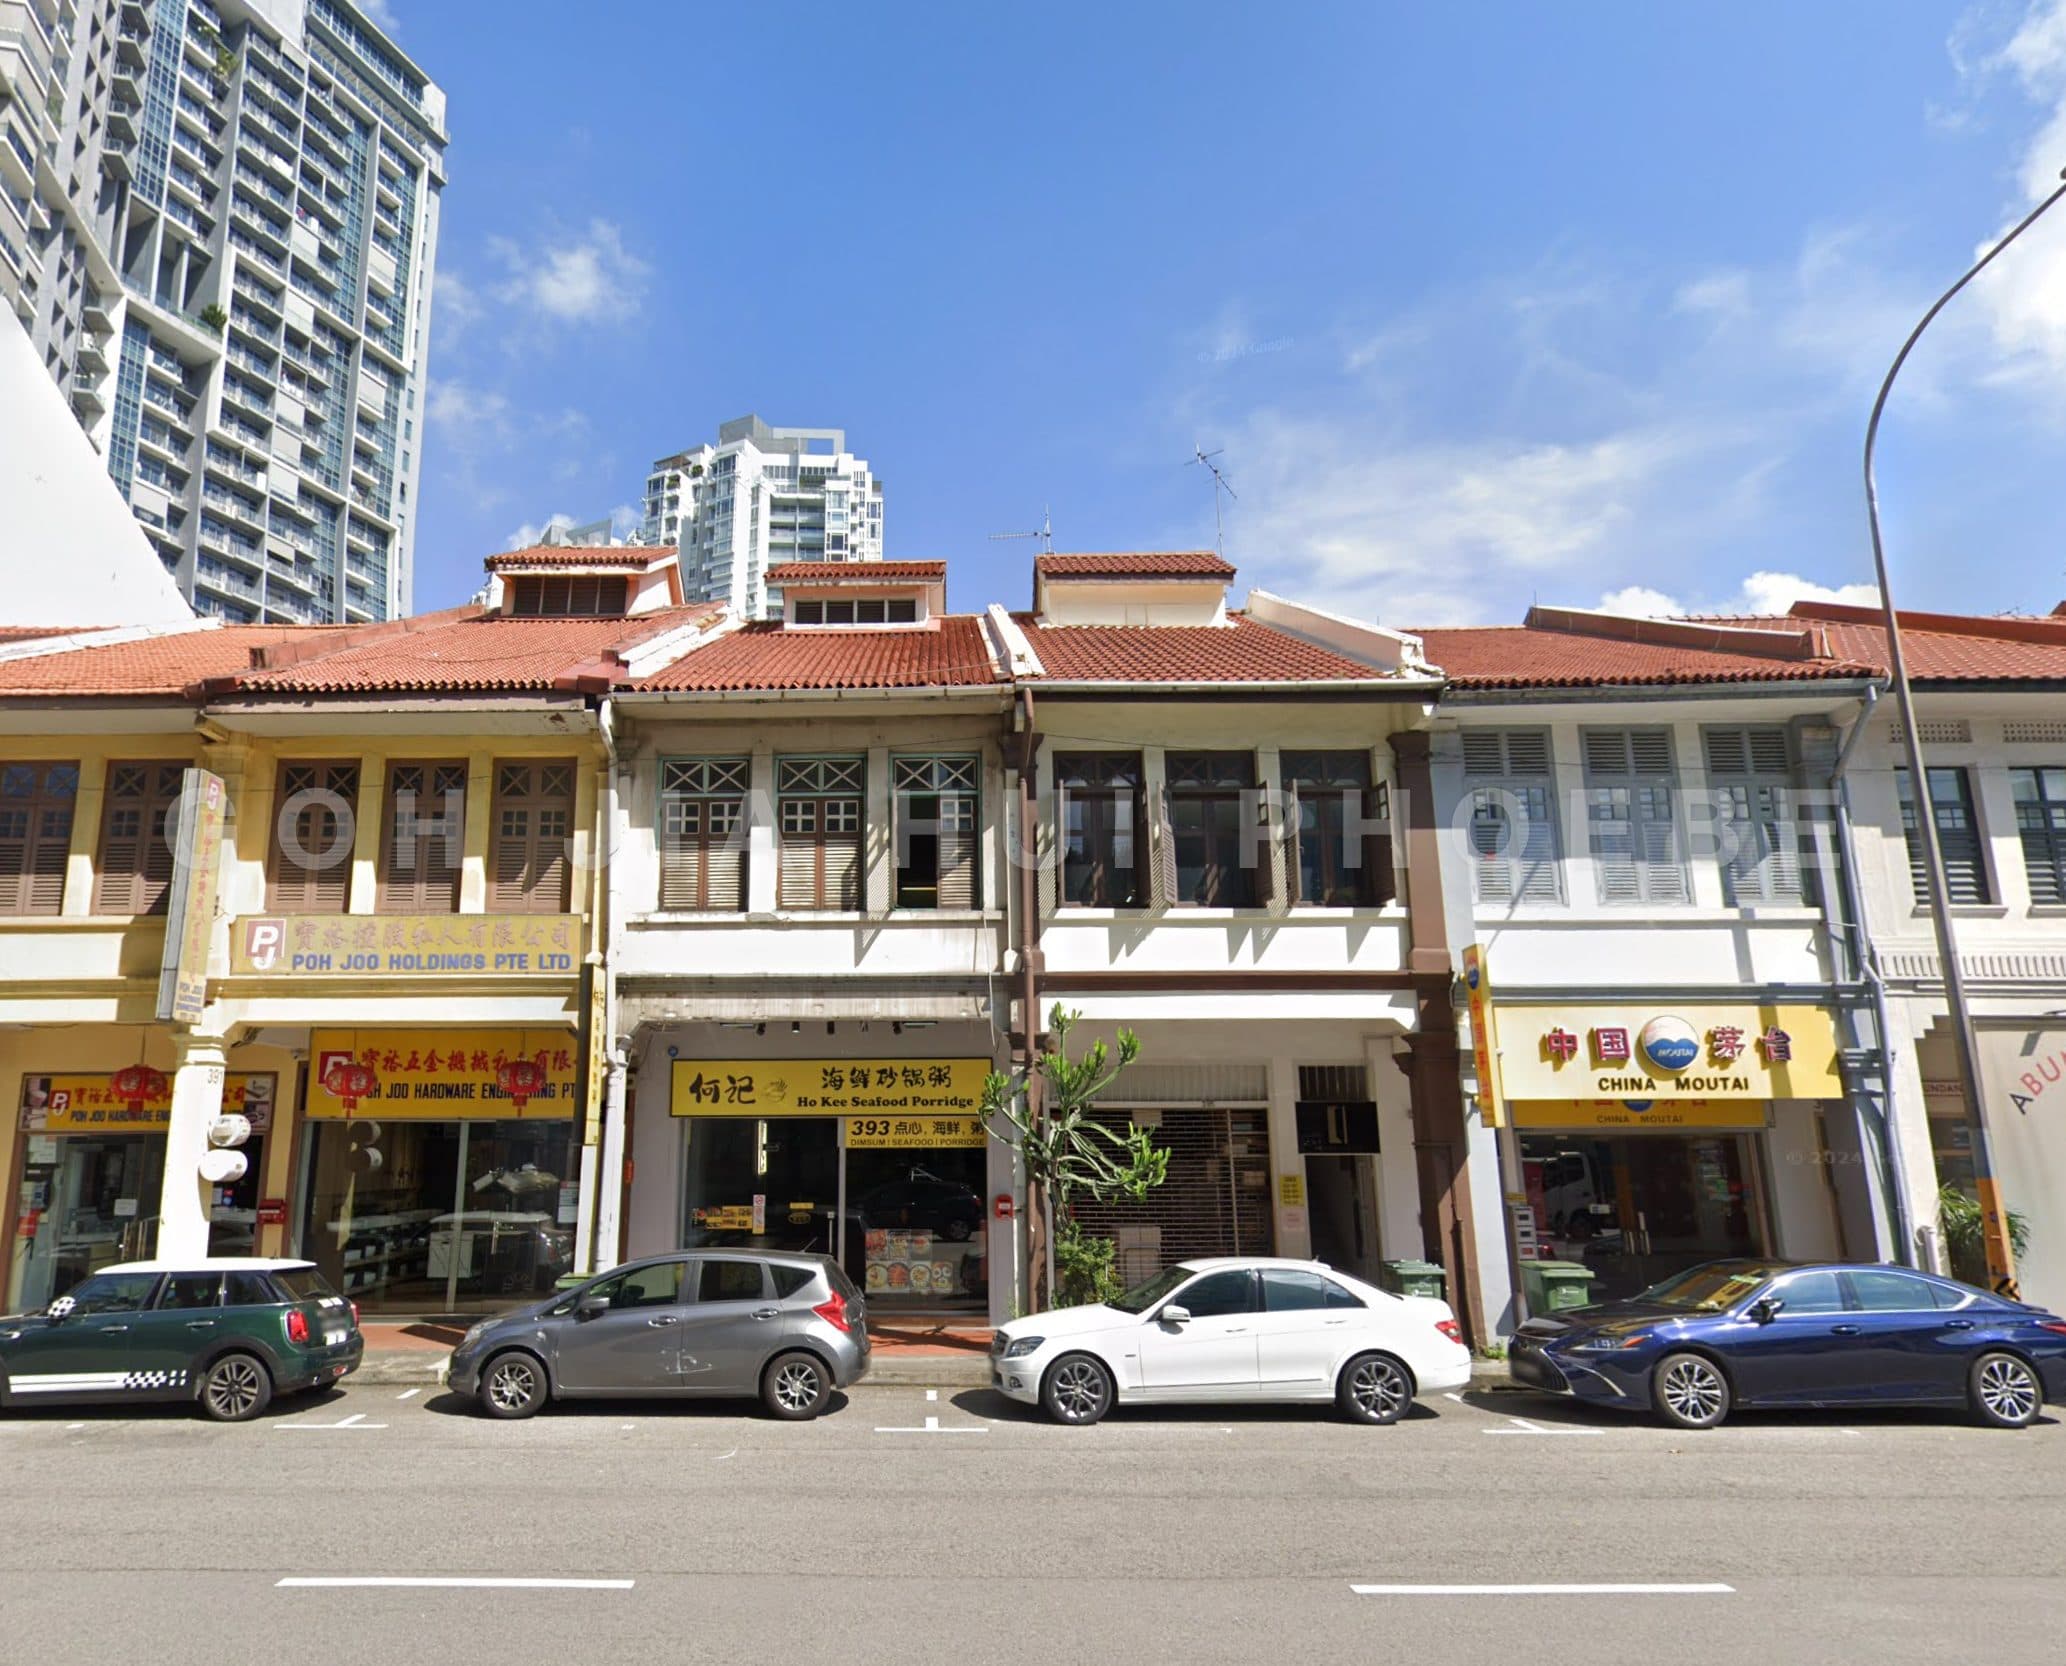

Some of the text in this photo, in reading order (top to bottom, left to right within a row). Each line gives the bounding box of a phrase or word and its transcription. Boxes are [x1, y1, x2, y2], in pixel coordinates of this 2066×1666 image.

[292, 954, 571, 970] POH JOO HOLDINGS PTE LTD
[1548, 1028, 1630, 1061] 中国
[386, 1083, 408, 1099] JOO
[415, 1083, 475, 1099] HARDWARE
[689, 1072, 756, 1104] 何记
[1598, 1077, 1749, 1091] CHINA MOUTAI
[797, 1096, 974, 1109] Ho Kee Seafood Porridge
[1597, 1115, 1683, 1124] CHINA MOUTAI
[852, 1120, 890, 1136] 393
[940, 1138, 984, 1146] PORRIDGE
